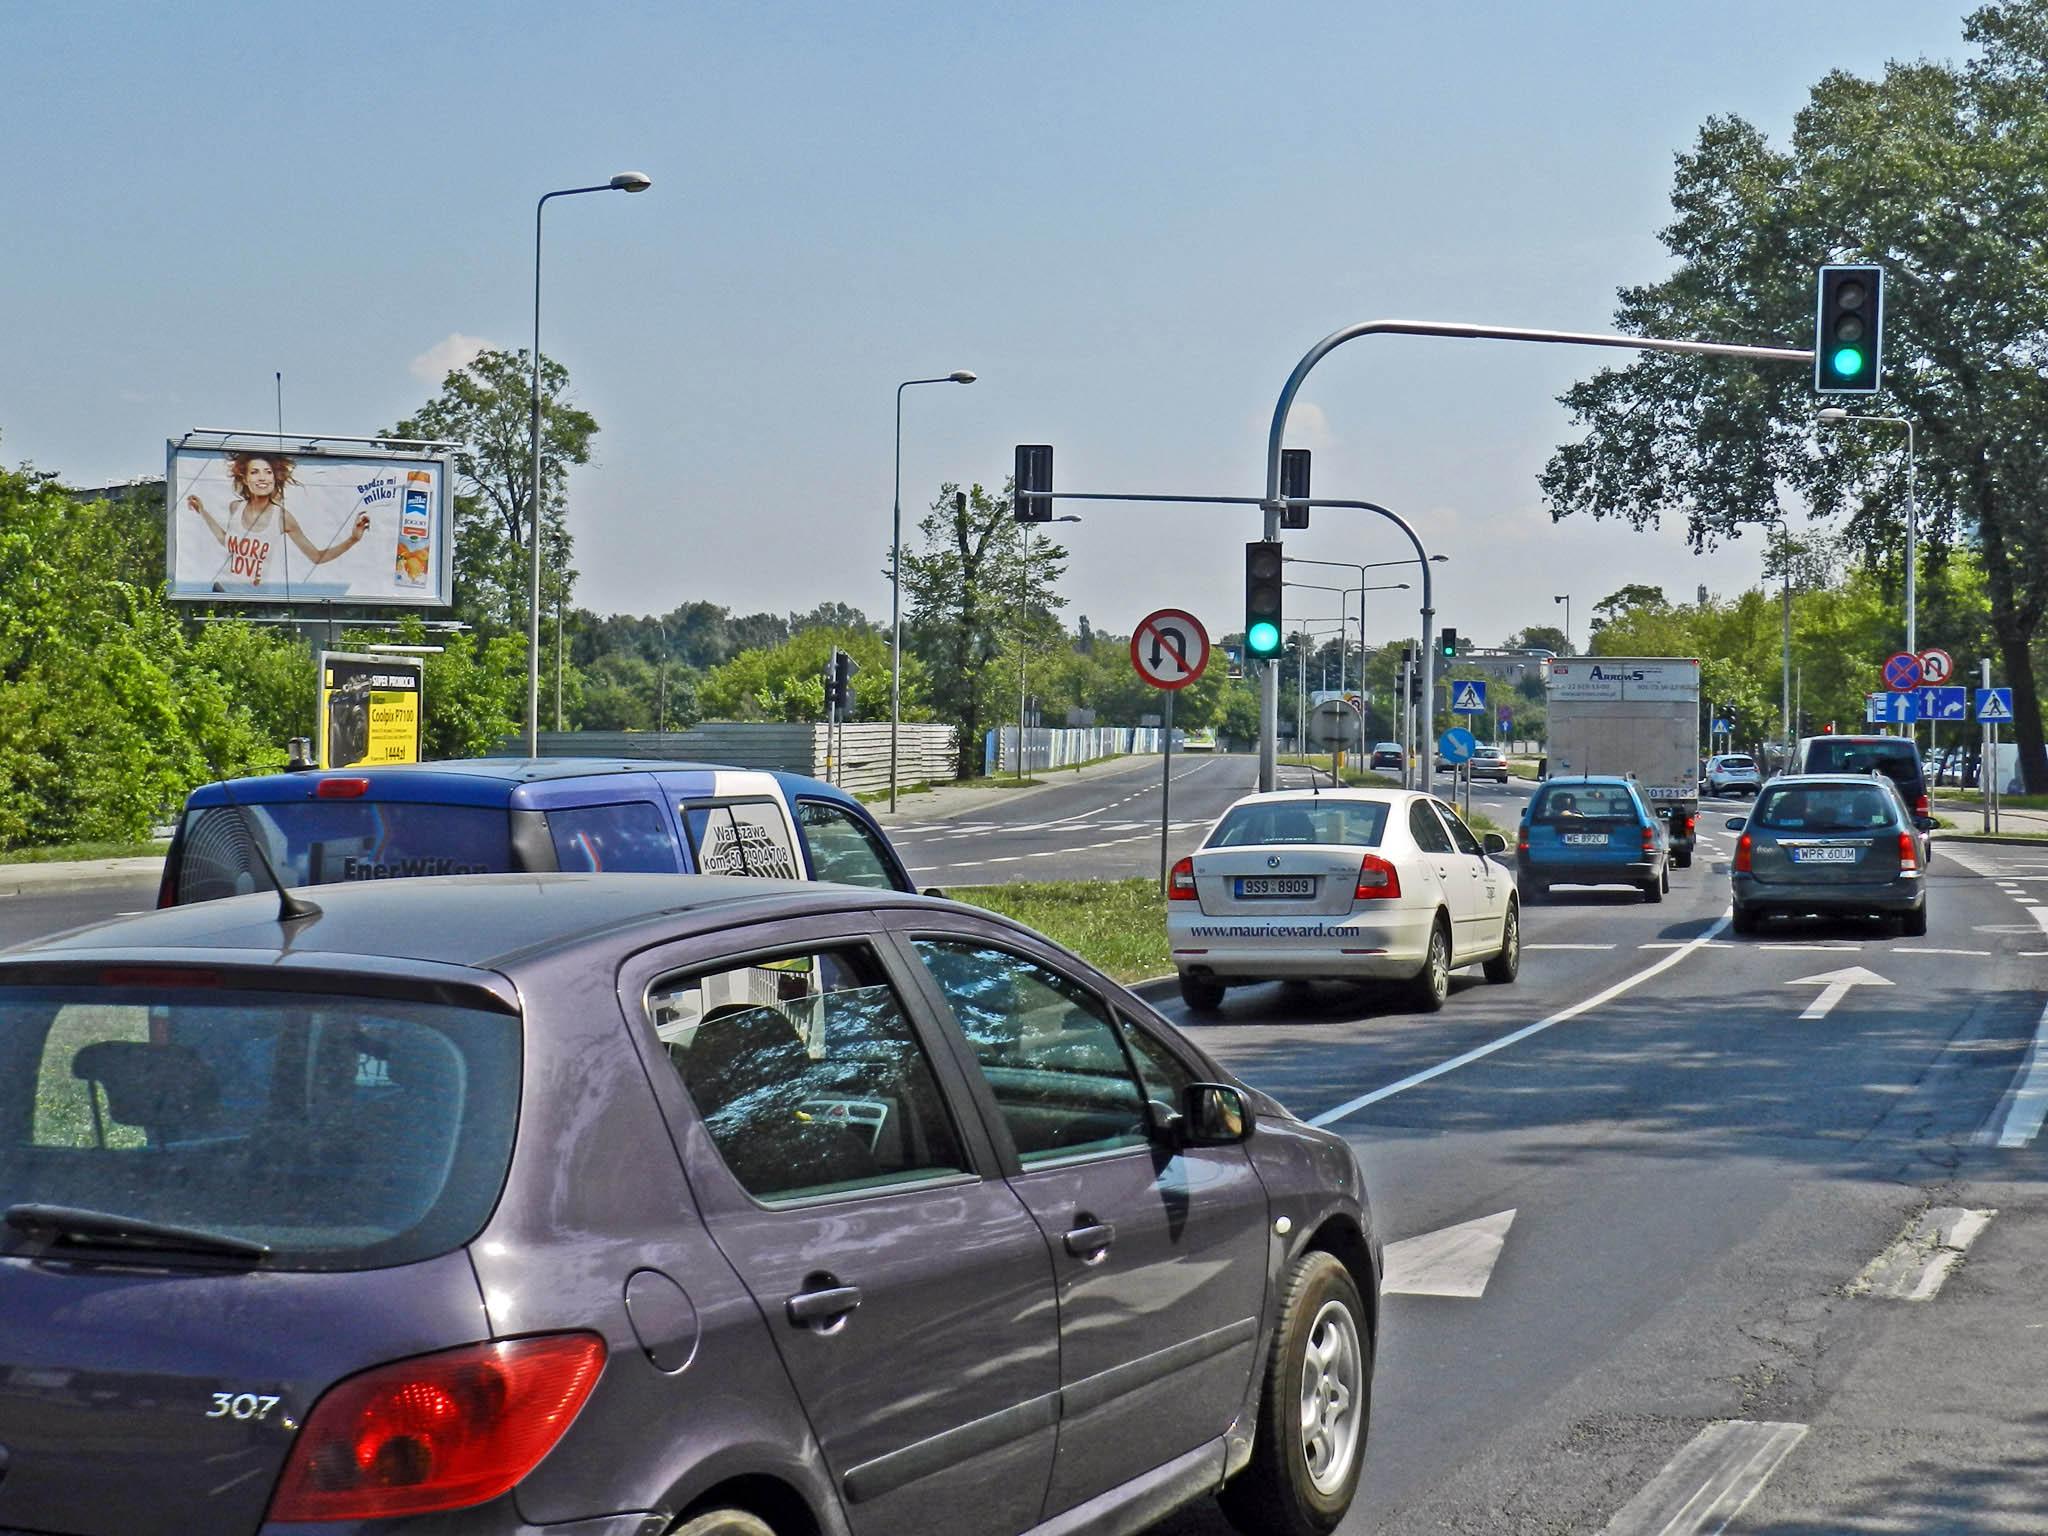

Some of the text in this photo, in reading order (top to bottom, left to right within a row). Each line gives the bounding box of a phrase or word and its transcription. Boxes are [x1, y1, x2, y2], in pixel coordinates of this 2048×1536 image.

[363, 488, 396, 505] milko!
[228, 535, 269, 560] MORE
[231, 555, 263, 577] LOVE
[714, 826, 766, 841] Warszawa
[1801, 849, 1825, 859] WPR
[1246, 880, 1309, 893] 9S9 8909
[1191, 923, 1360, 938] www.mauriceward.com
[206, 1391, 281, 1420] 307
